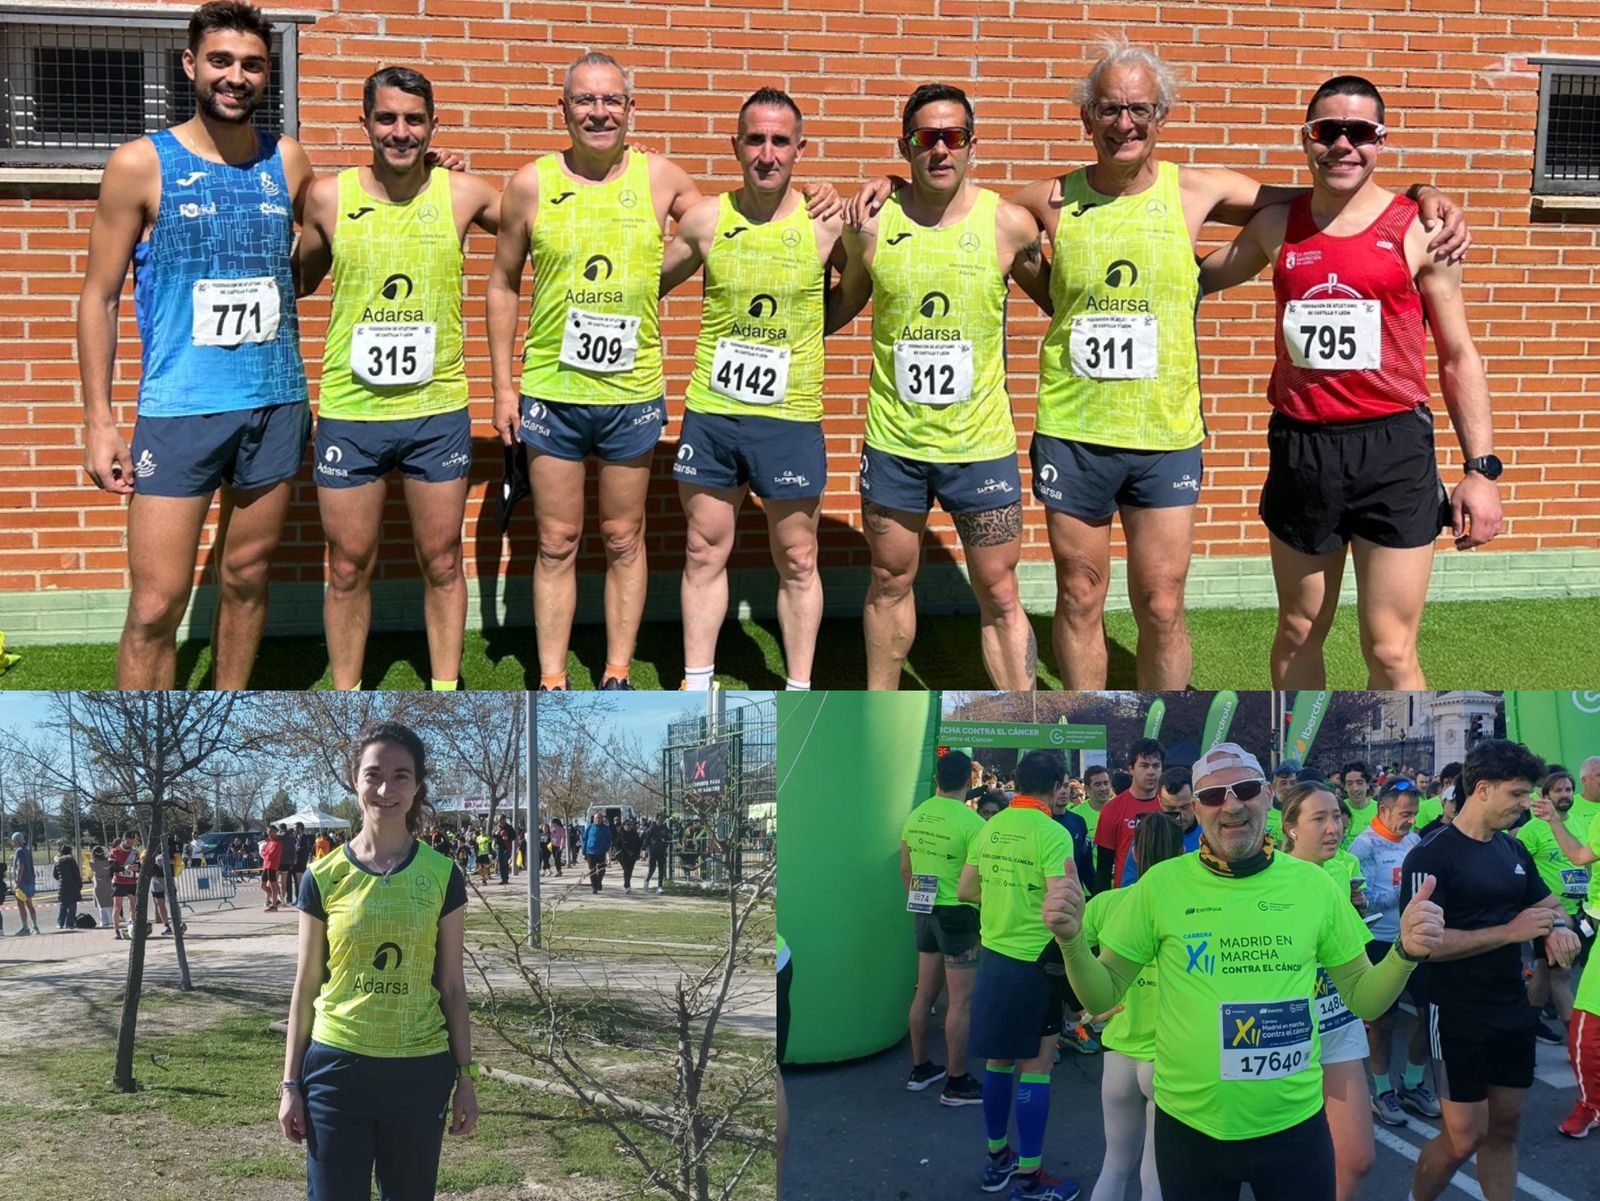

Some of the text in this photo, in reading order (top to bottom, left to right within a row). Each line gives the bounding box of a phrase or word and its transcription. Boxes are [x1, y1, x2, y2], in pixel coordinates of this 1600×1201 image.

[564, 289, 623, 304] Adarsa
[1085, 295, 1150, 312] Adarsa
[212, 301, 261, 336] 771
[362, 307, 424, 322] Adarsa
[731, 322, 787, 340] Adarsa
[901, 325, 961, 341] Adarsa
[576, 333, 623, 365] 309
[1300, 325, 1356, 360] 795
[368, 345, 417, 376] 315
[1086, 336, 1133, 369] 311
[717, 360, 777, 397] 4142
[908, 364, 955, 395] 312
[317, 462, 348, 477] Adarsa
[962, 727, 996, 736] CONTRA
[997, 728, 1006, 736] EL
[1008, 726, 1040, 736] CÁNCER
[1220, 935, 1293, 948] MADRID EN
[1186, 940, 1216, 976] XII
[1221, 949, 1279, 962] MARCHA
[1222, 965, 1262, 974] CONTRA
[1262, 964, 1274, 972] EL
[352, 976, 409, 995] Adarsa
[1232, 1016, 1261, 1047] XII
[1262, 1030, 1285, 1038] contra
[1286, 1028, 1293, 1036] el
[1240, 1050, 1302, 1076] 17640
